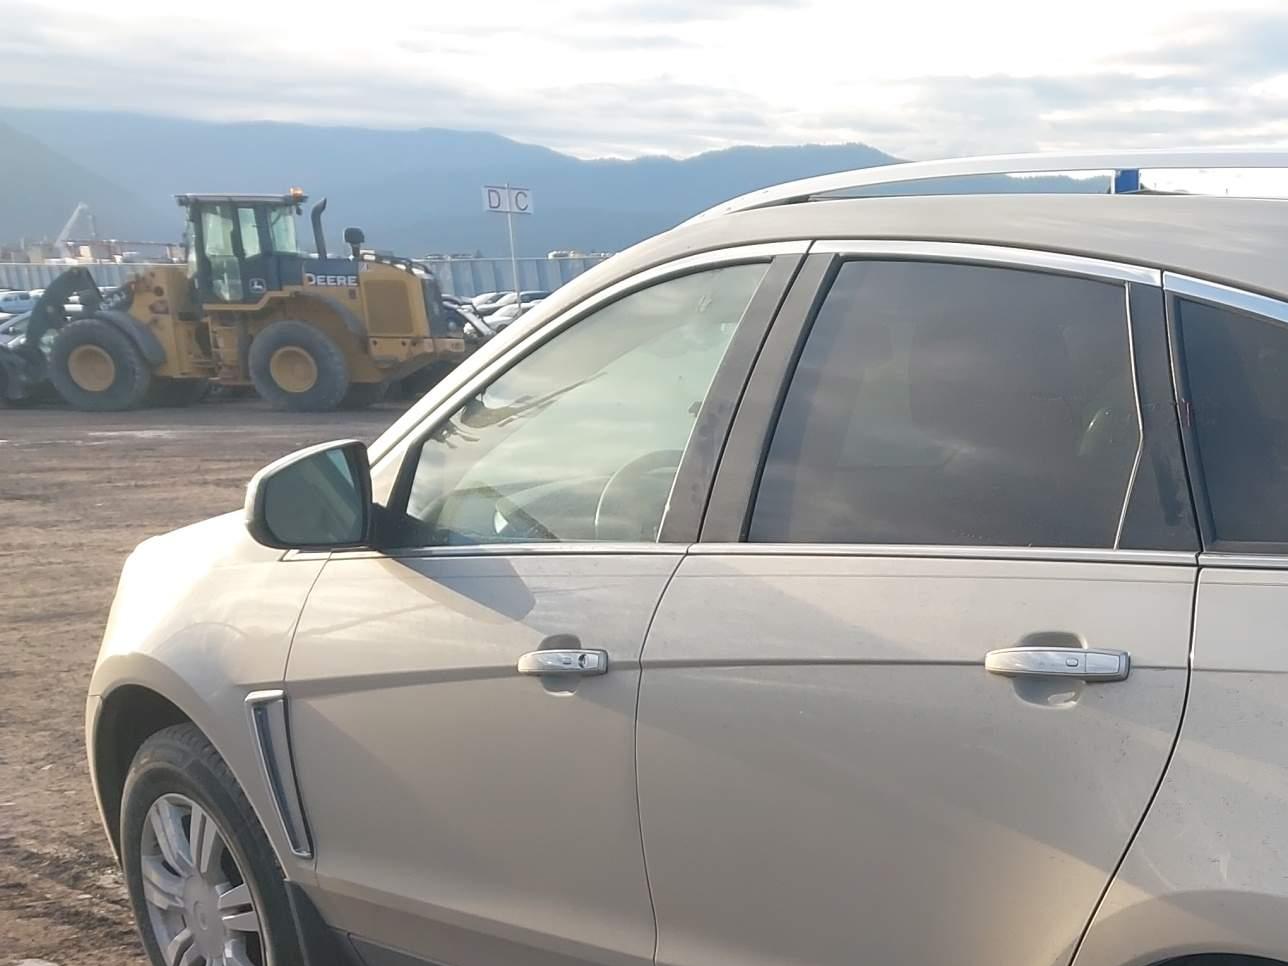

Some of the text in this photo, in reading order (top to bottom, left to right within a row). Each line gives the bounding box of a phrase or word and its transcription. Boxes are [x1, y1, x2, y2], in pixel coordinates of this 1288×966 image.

[488, 189, 529, 211] D C
[305, 273, 358, 287] DEERE
